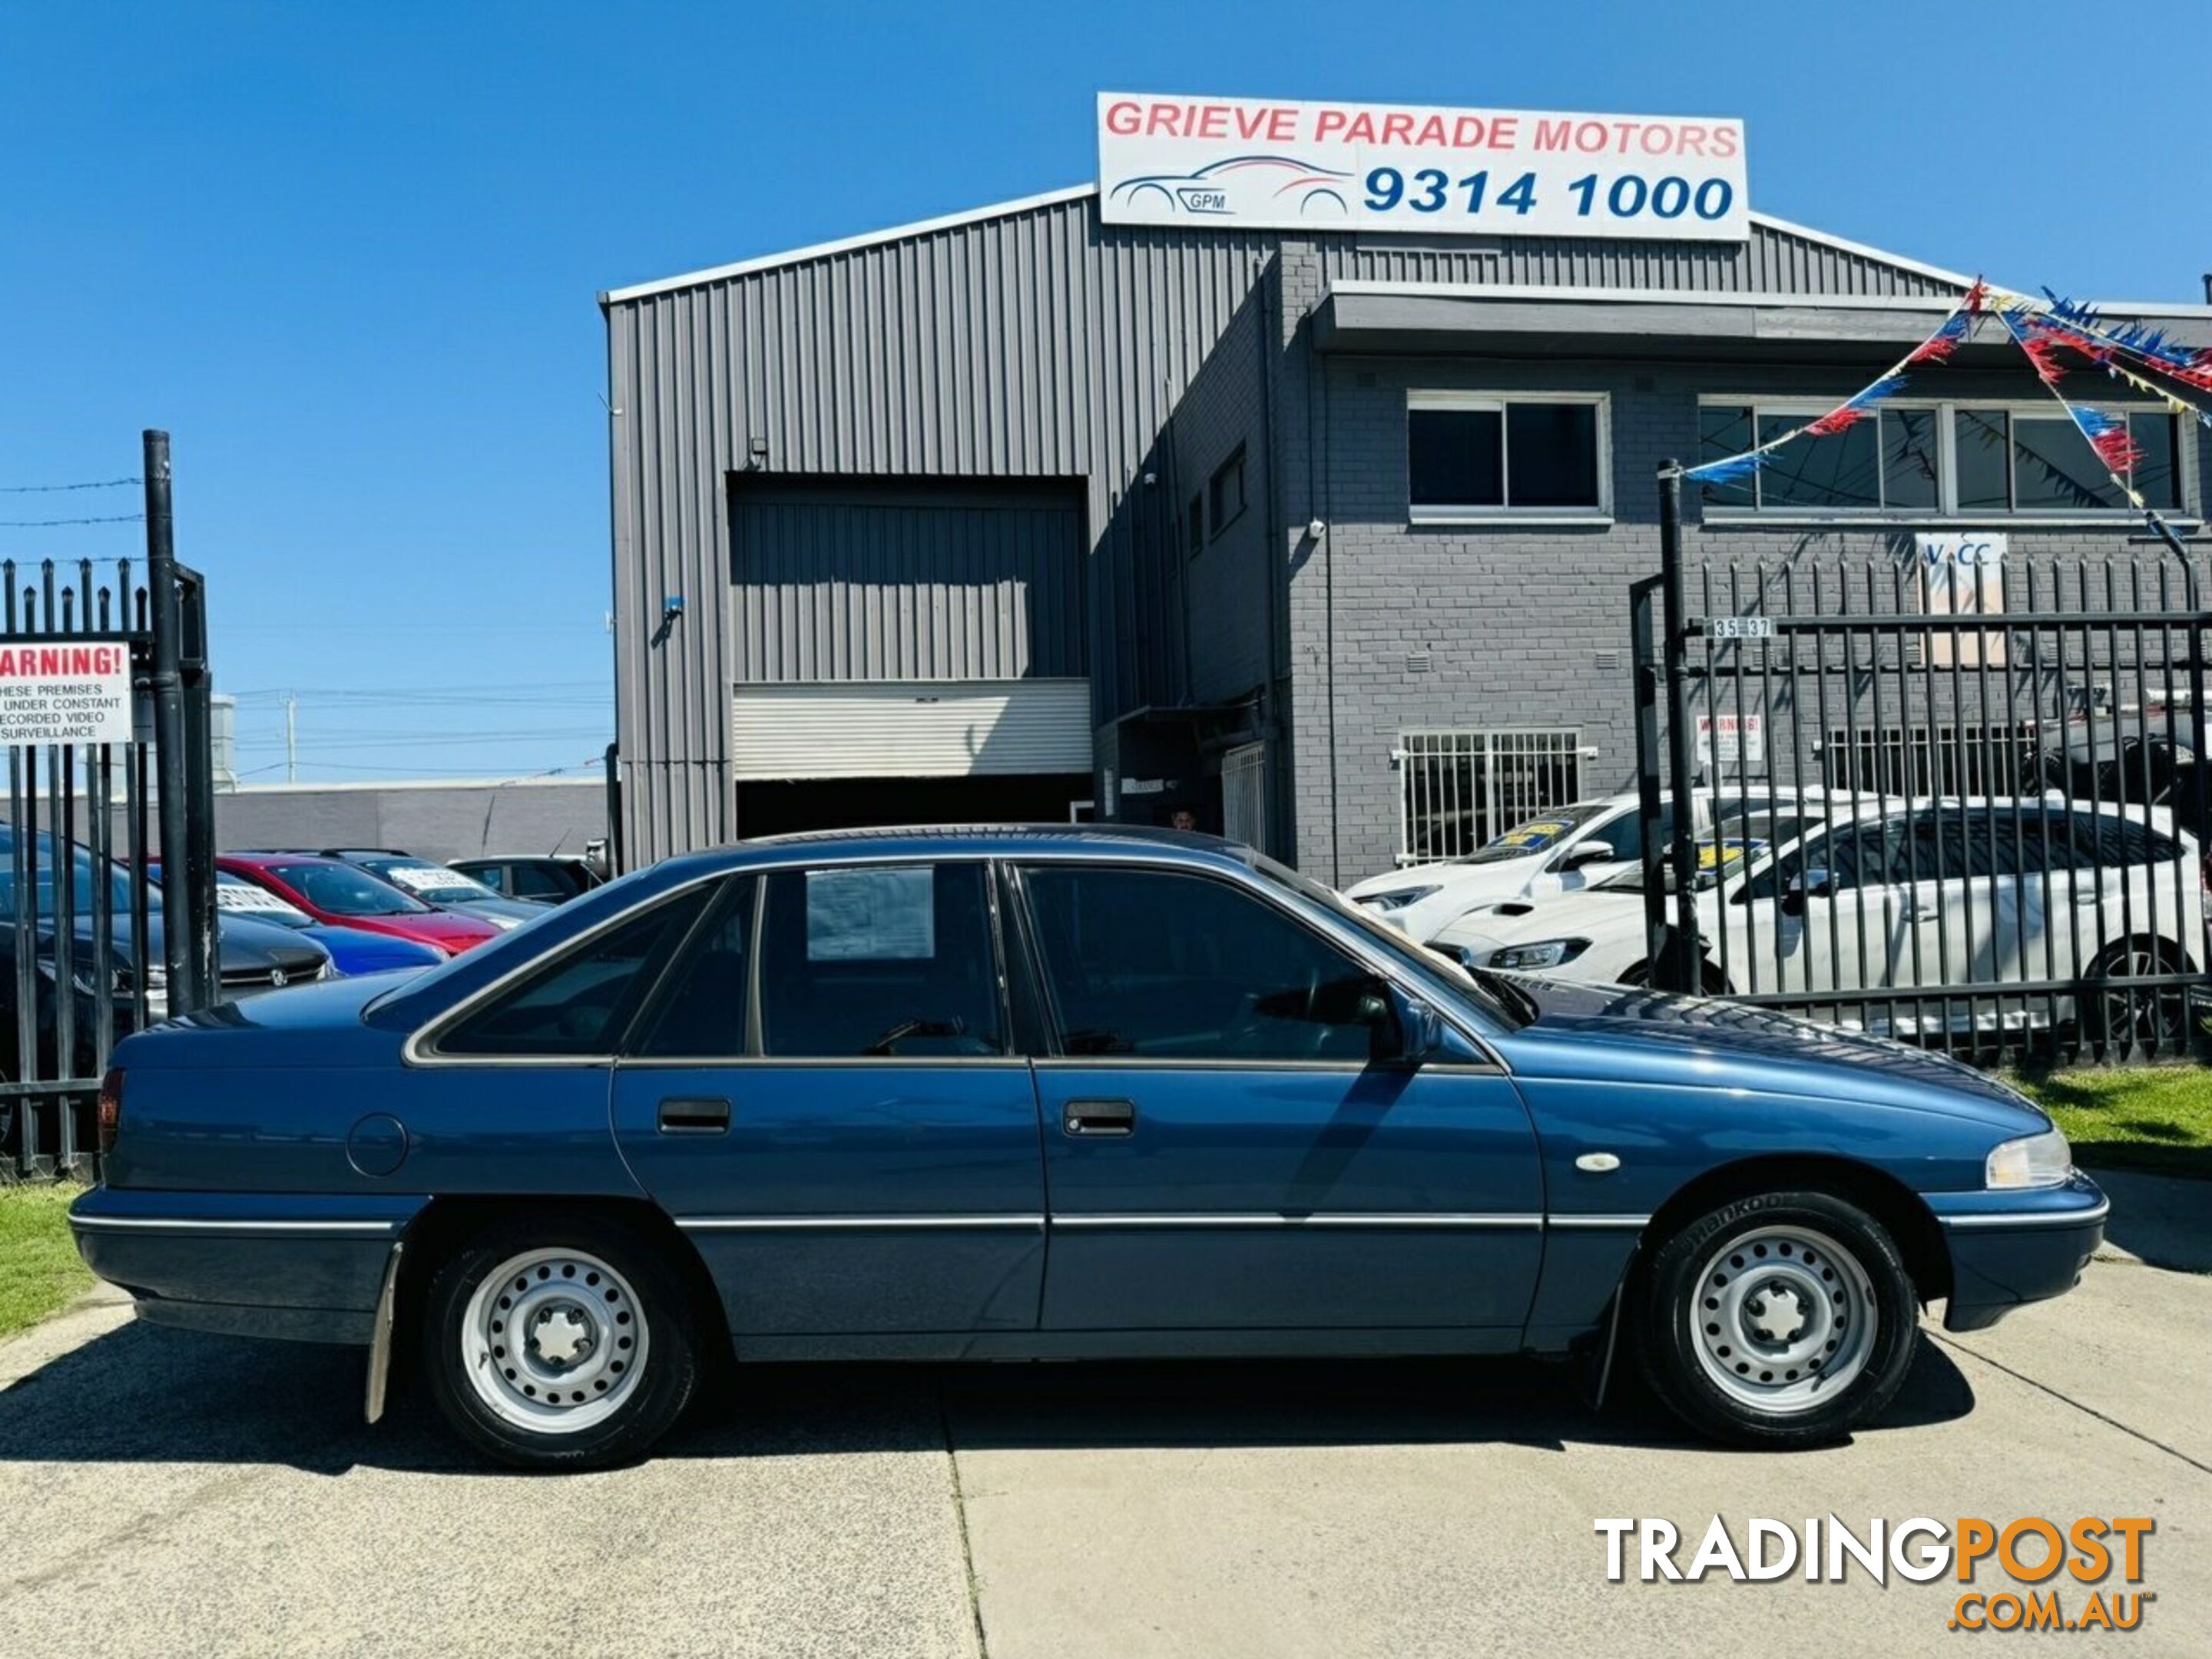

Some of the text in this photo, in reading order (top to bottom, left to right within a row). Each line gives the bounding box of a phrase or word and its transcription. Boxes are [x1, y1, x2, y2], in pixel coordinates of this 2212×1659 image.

[1106, 101, 1737, 159] GRIEVE PARADE MOTORS
[1190, 193, 1227, 209] GPM
[1363, 166, 1734, 220] 9314 1000
[1926, 543, 1991, 566] VCC
[0, 647, 121, 677] ARNING!
[0, 684, 103, 697] HESE PREMISES
[4, 697, 121, 711] UNDER CONSTANT
[0, 711, 105, 725] ECORDED VIDEO
[1, 725, 97, 740] SURVEILLANCE
